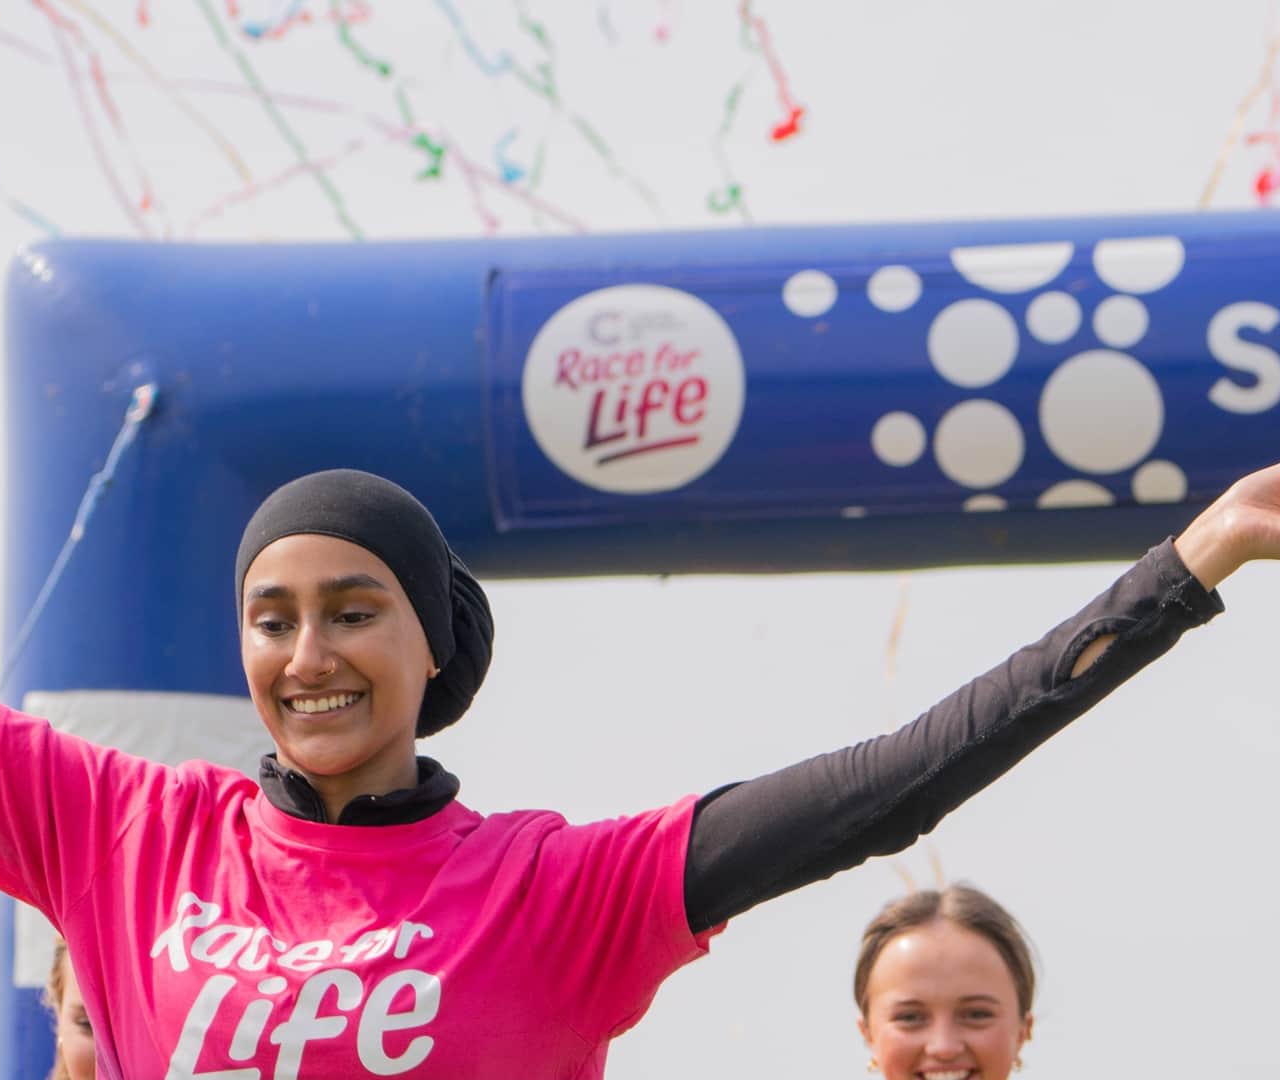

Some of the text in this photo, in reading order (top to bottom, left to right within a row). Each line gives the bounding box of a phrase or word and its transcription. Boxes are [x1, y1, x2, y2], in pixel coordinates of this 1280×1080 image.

[554, 342, 702, 391] Race for
[583, 376, 709, 452] Life
[150, 891, 334, 972] Race
